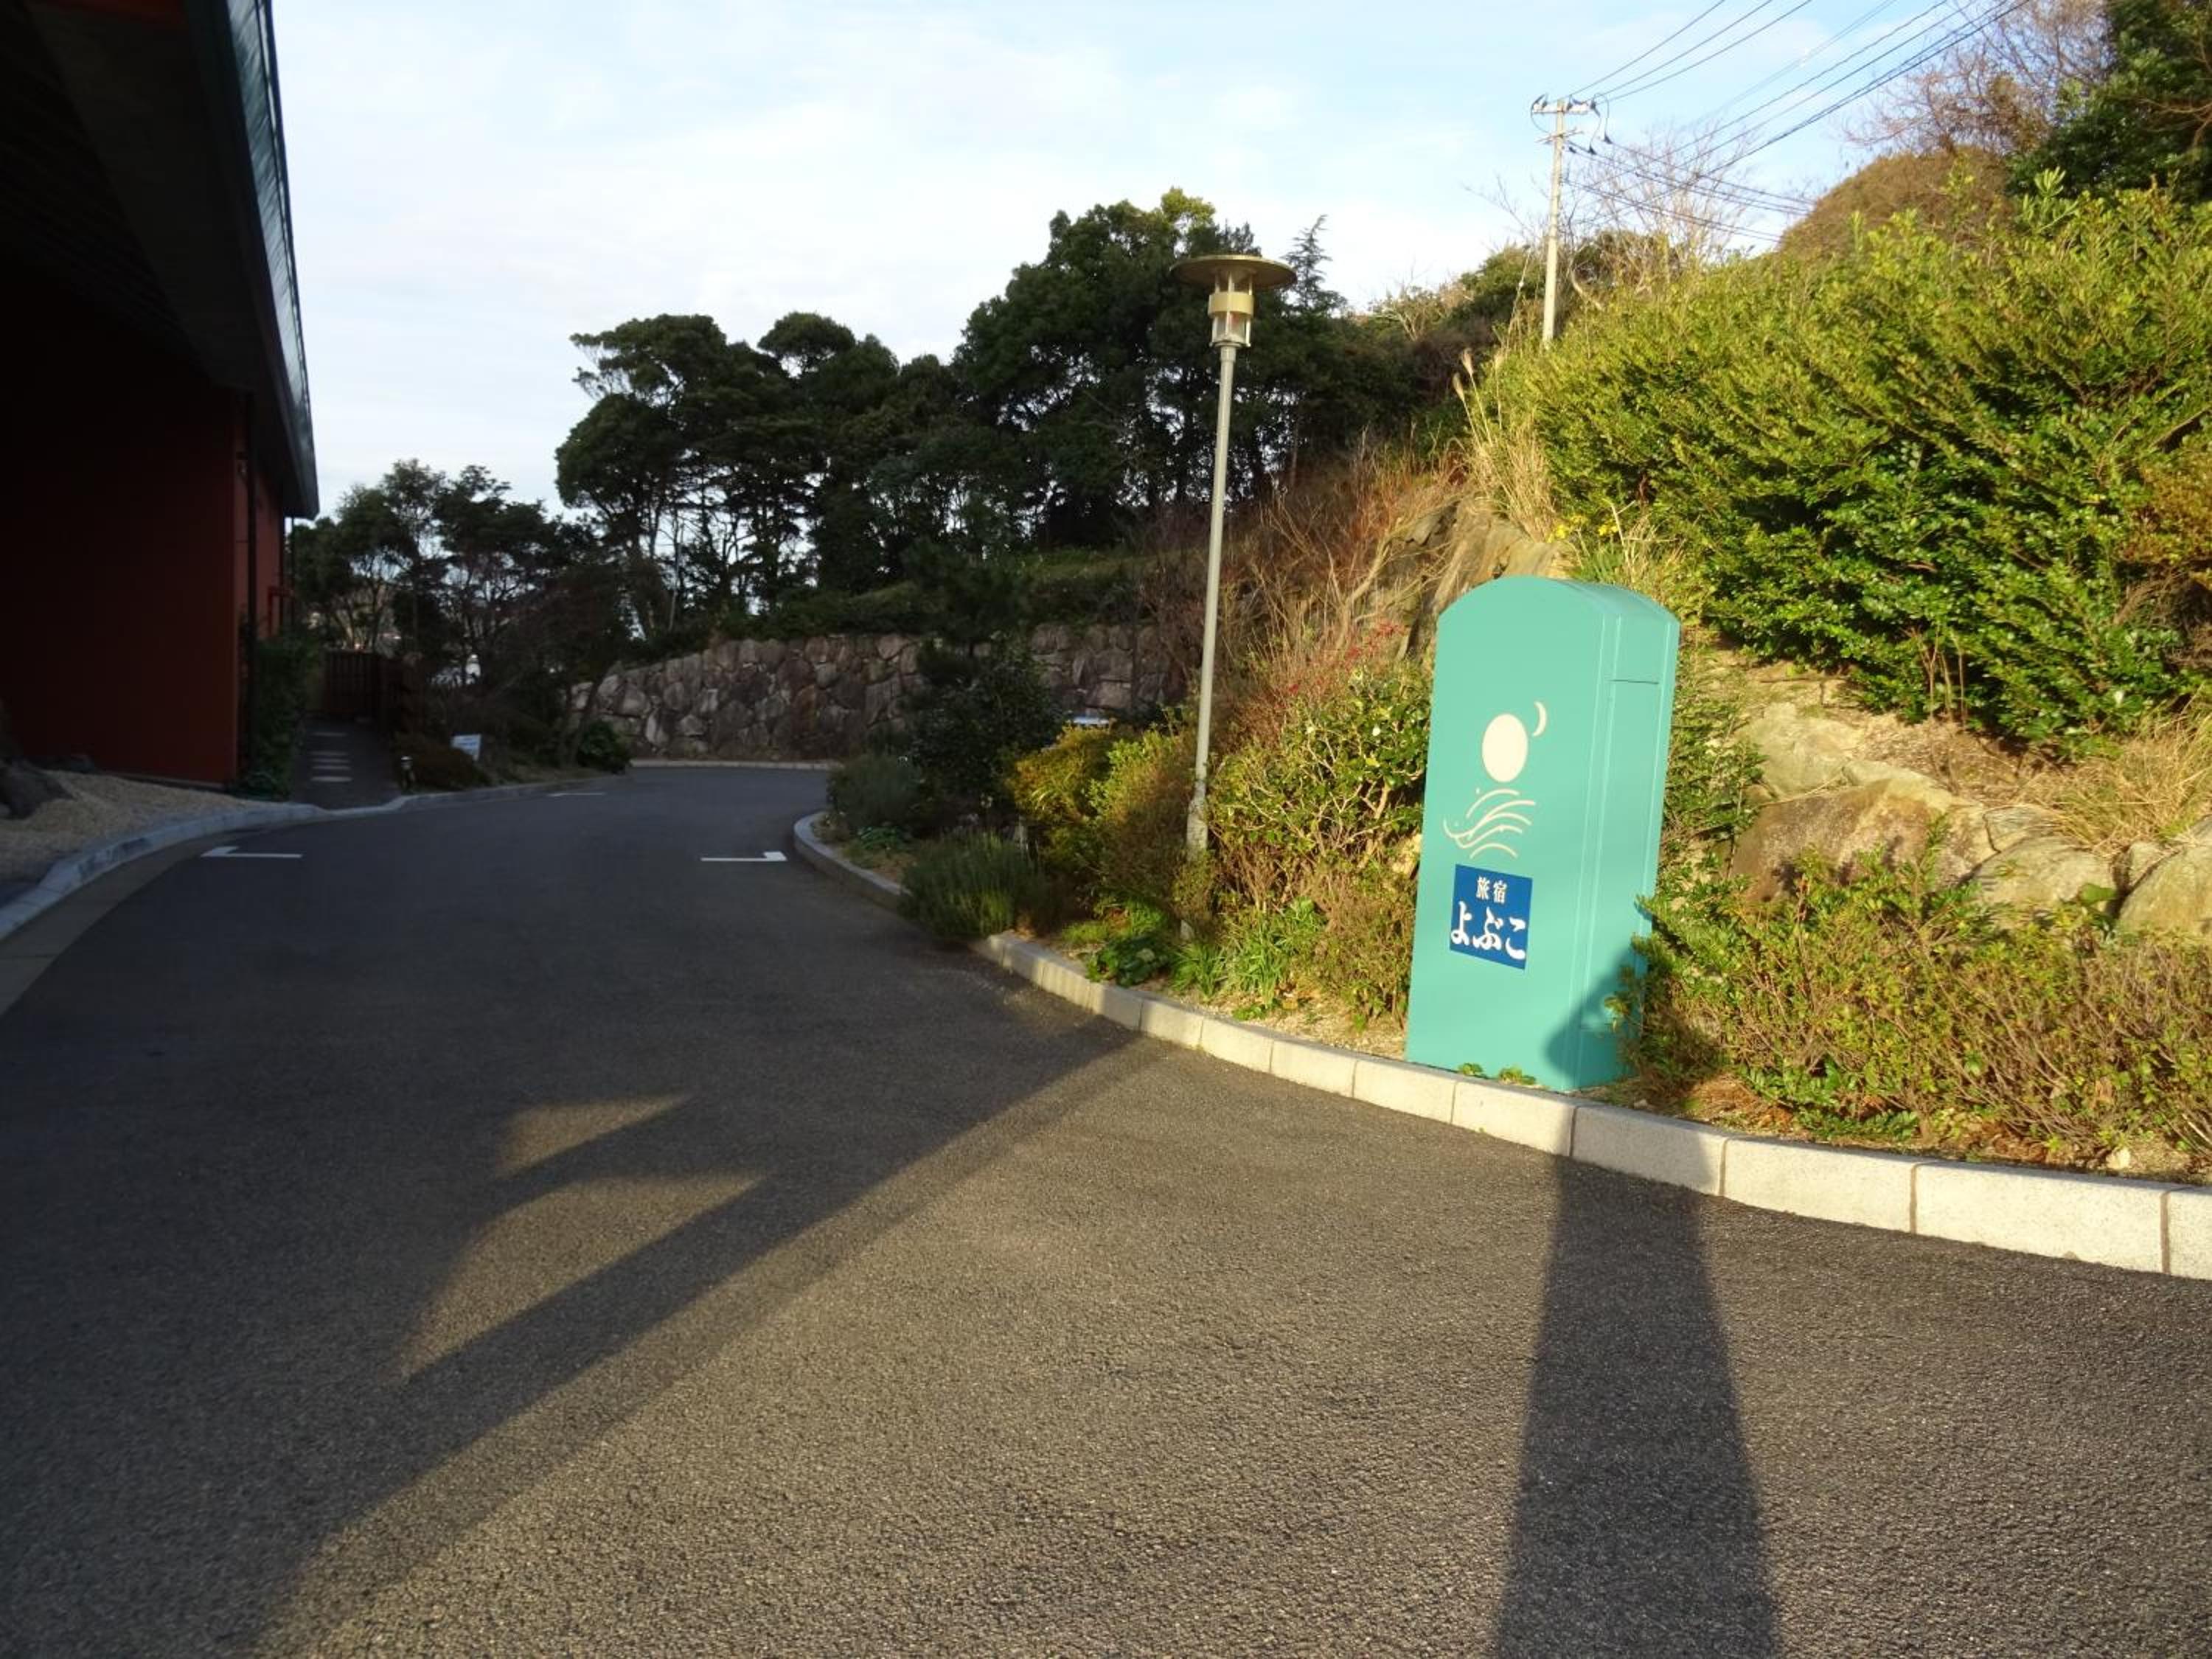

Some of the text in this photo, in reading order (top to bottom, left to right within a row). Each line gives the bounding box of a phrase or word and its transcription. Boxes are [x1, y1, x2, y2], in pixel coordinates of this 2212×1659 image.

[1475, 876, 1508, 905] 旅宿
[1450, 900, 1526, 959] よぶこ
